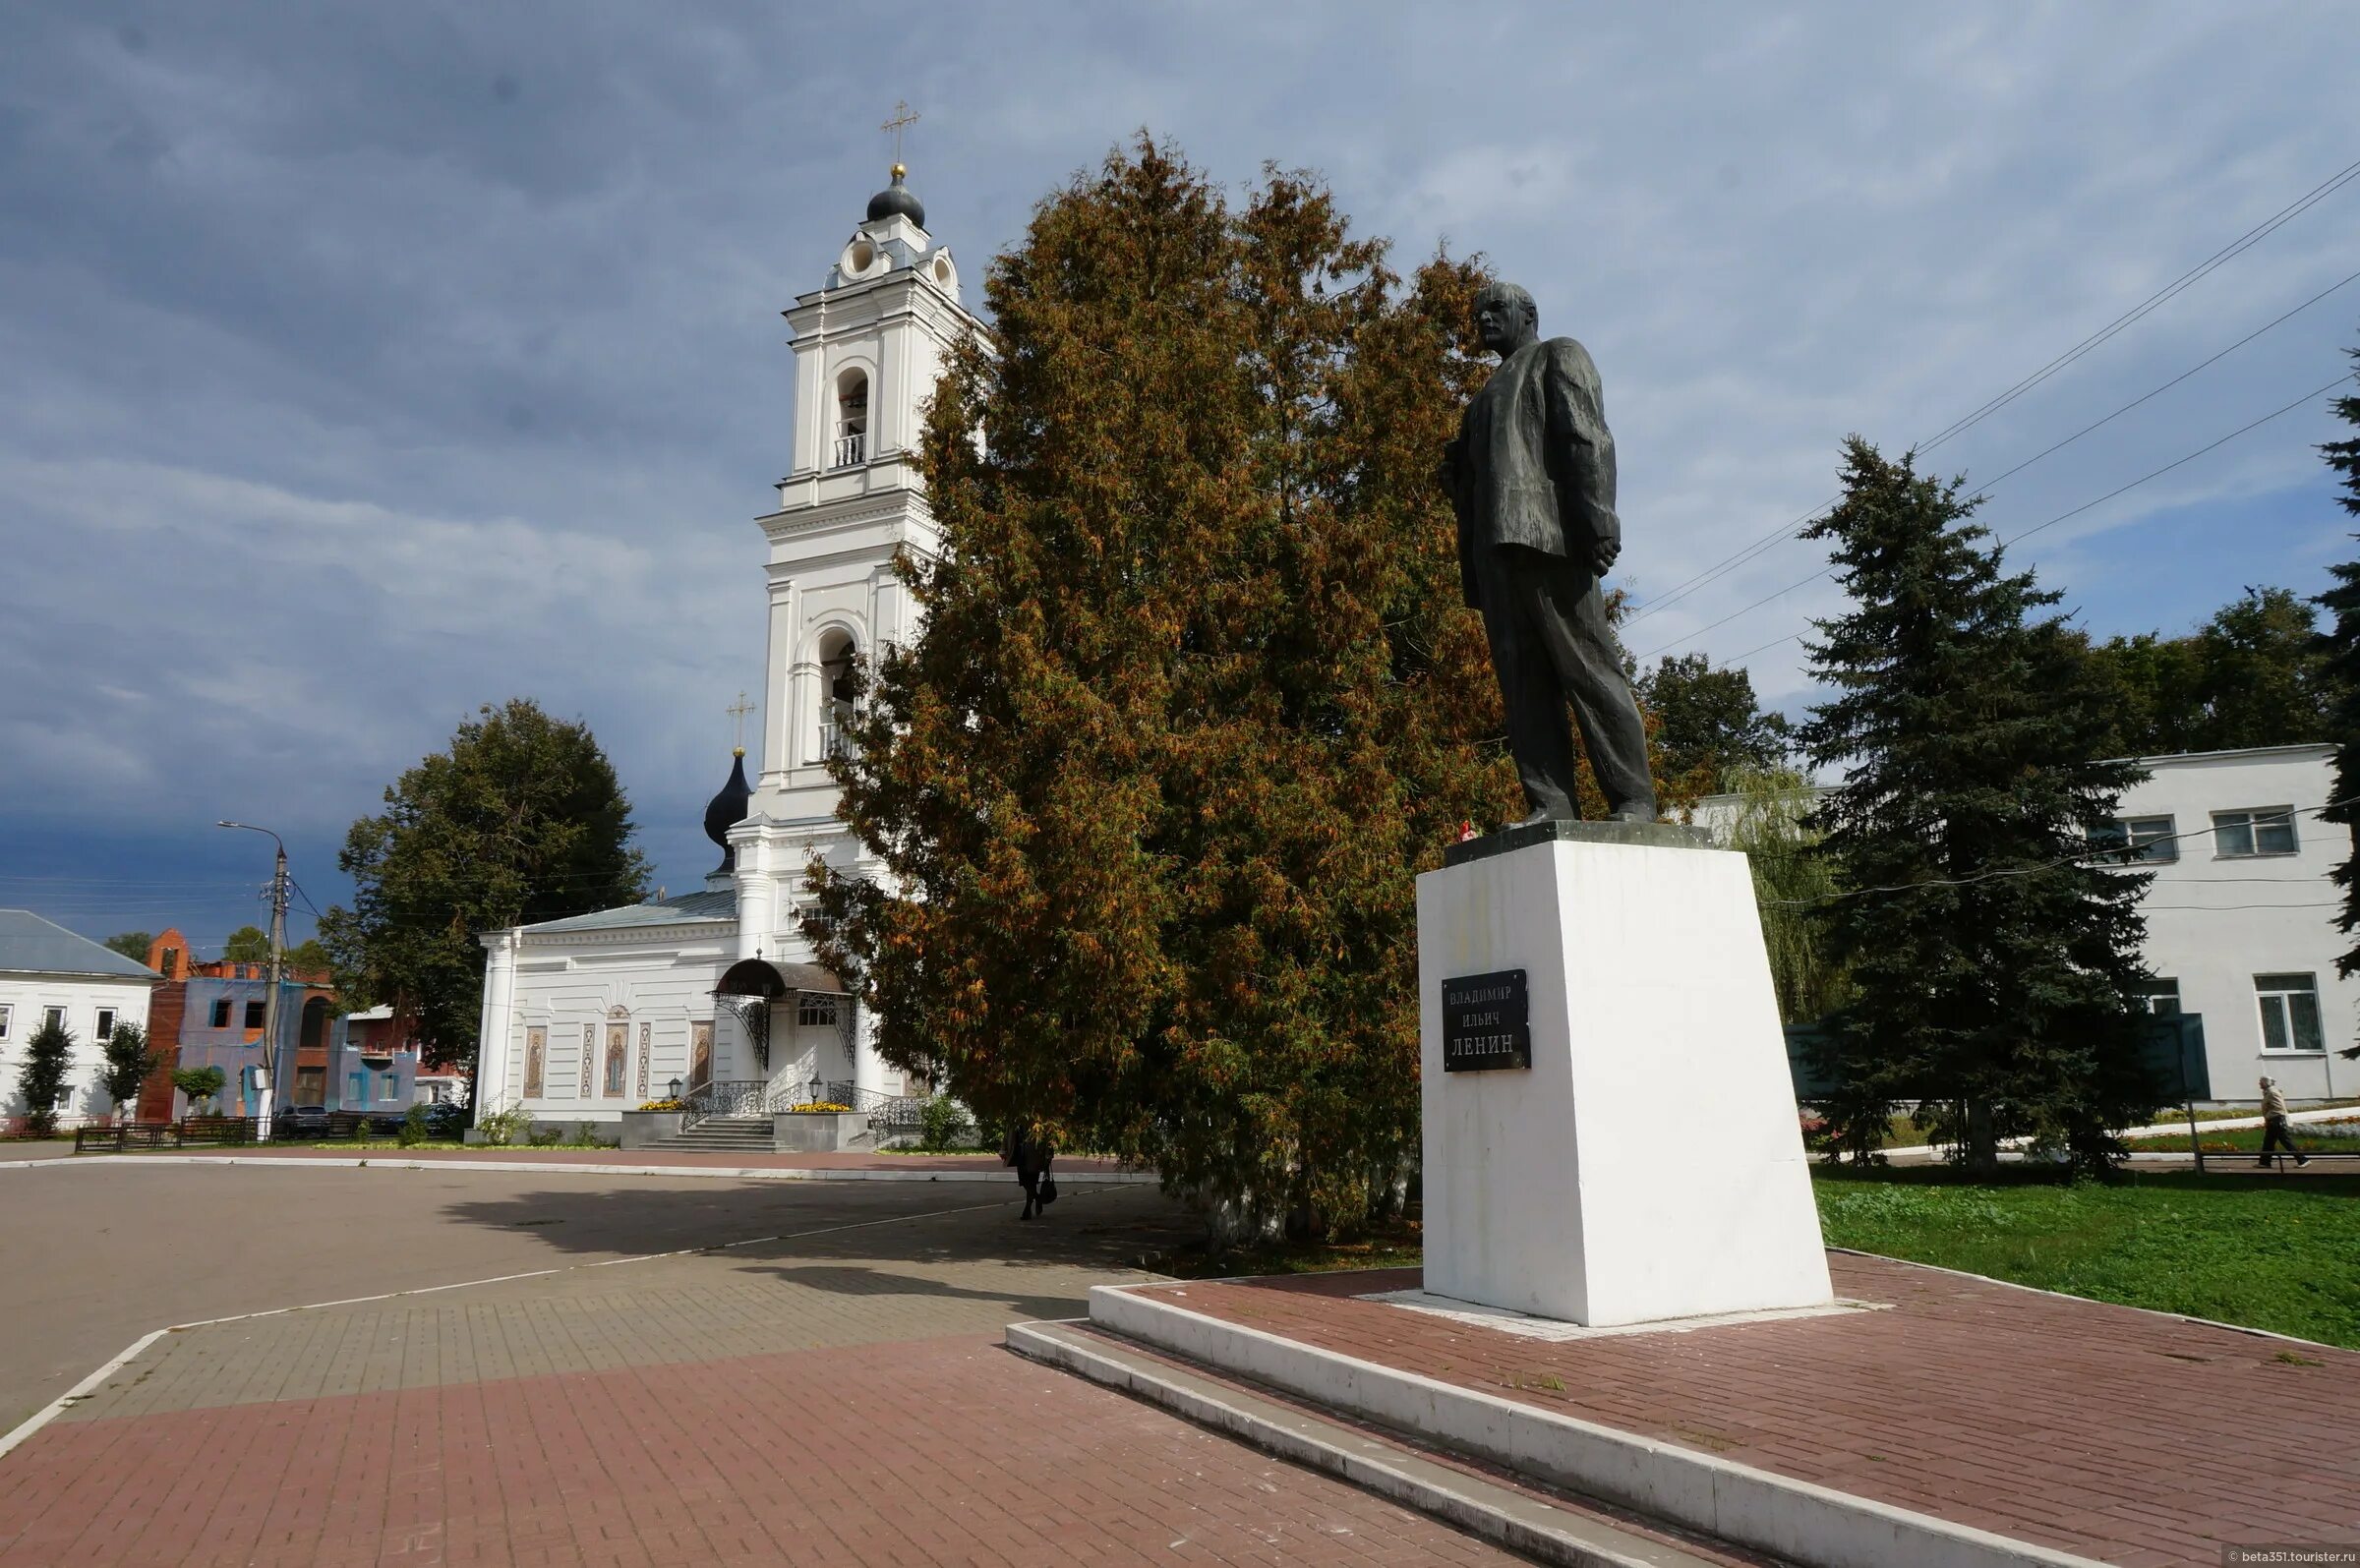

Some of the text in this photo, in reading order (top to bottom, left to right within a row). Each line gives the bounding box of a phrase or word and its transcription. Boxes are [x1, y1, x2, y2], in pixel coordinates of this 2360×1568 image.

[1449, 986, 1511, 1006] ВЛАДИМИР
[1462, 1012, 1500, 1027] ИЛЬИЧ
[1451, 1034, 1513, 1056] ЛЕНИН
